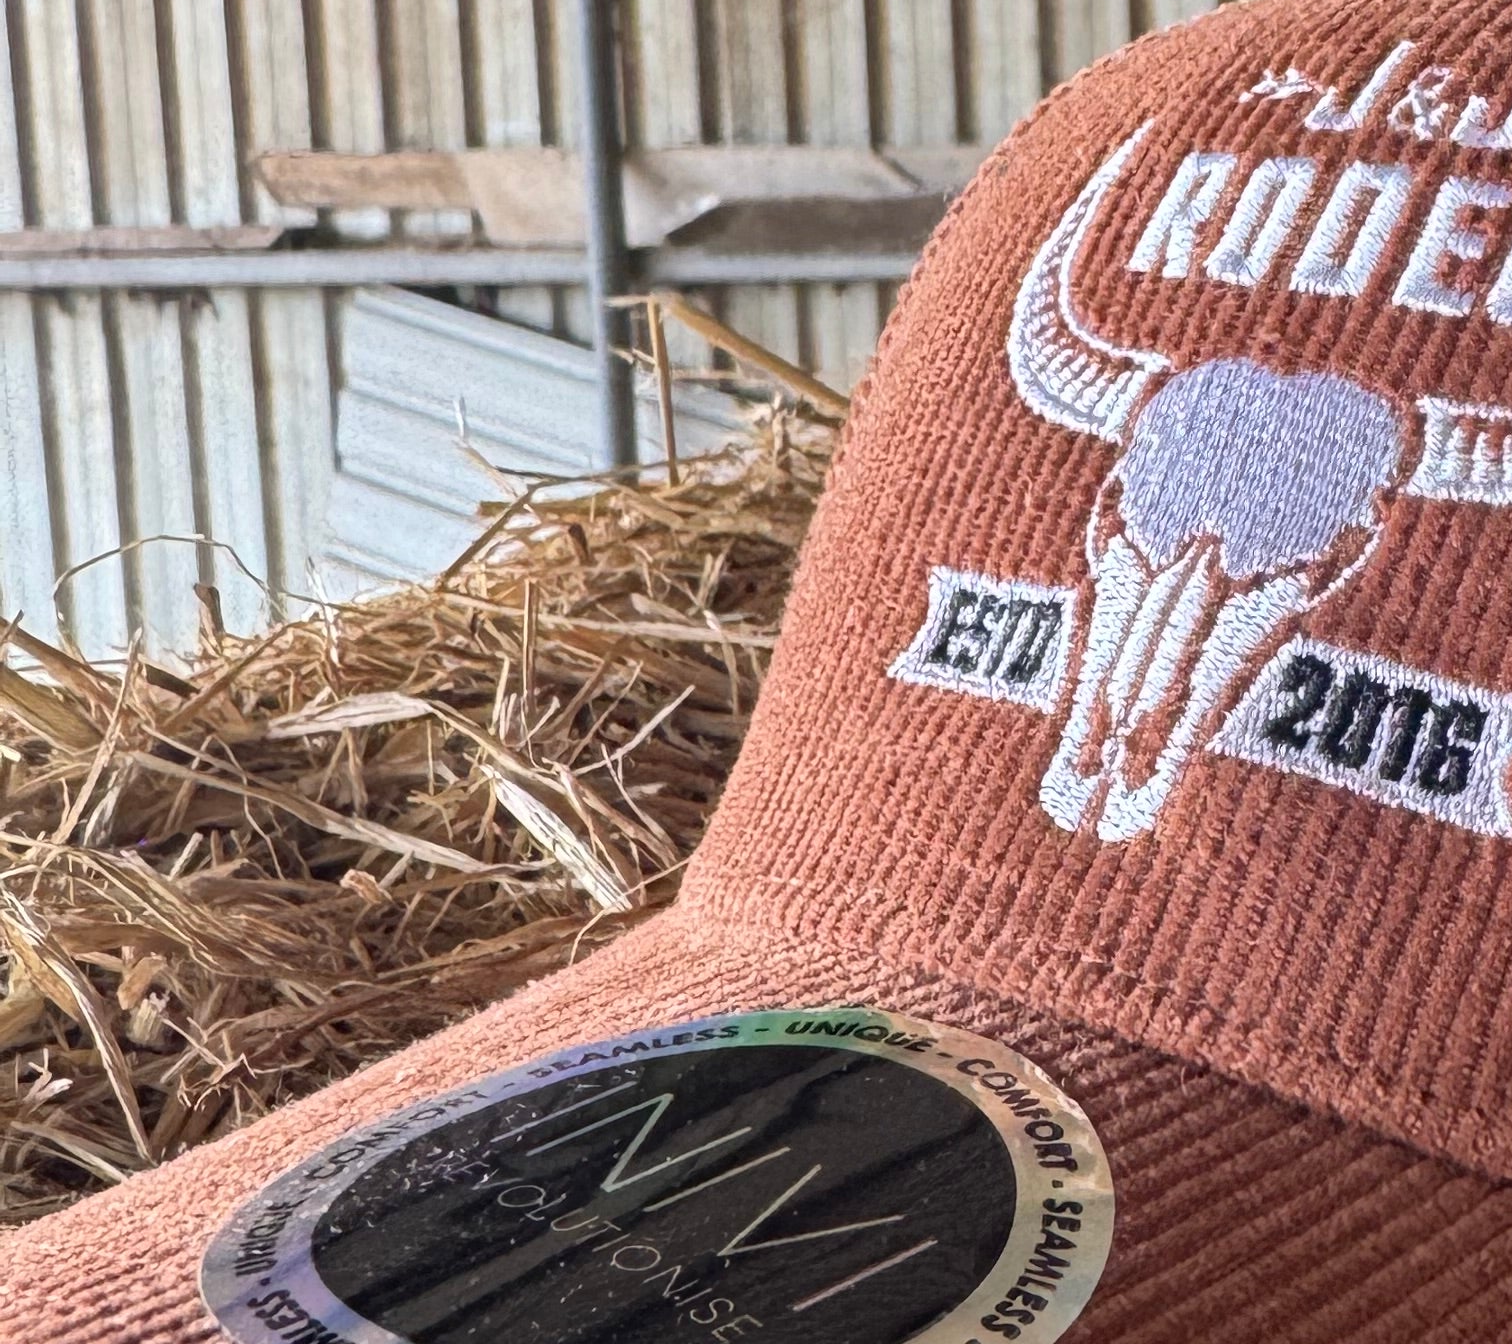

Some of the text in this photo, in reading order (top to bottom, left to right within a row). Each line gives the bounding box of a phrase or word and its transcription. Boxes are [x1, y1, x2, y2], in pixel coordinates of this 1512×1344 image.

[930, 588, 1490, 795] ESTD 2016
[527, 1023, 740, 1080] SEAMLESS
[784, 1019, 938, 1053] UNIQUE
[956, 1057, 1079, 1173] COMFORT
[981, 1198, 1084, 1342] SEAMLESS
